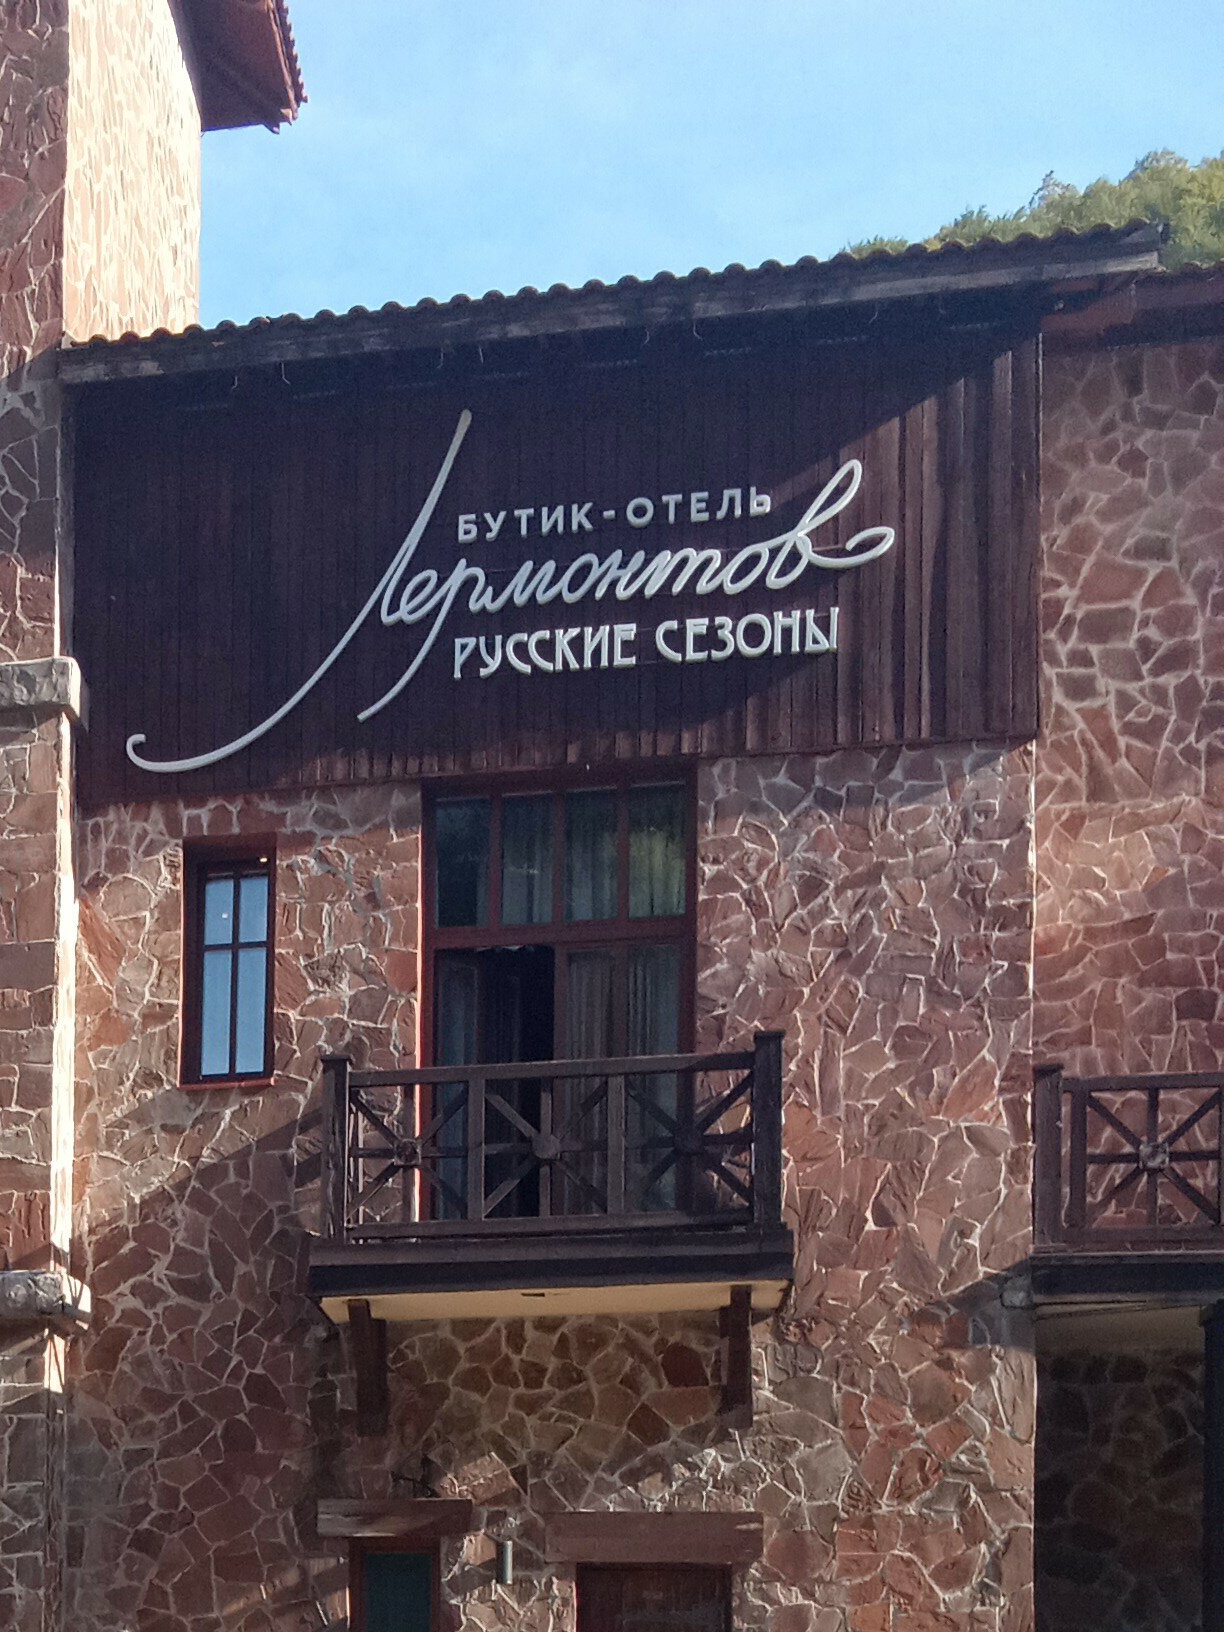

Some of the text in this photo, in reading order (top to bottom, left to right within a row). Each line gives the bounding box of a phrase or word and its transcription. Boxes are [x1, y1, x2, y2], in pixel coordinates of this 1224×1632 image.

[457, 486, 773, 543] БУТИК-ОТЕЛЬ
[126, 408, 896, 772] Лермонтов
[453, 606, 841, 680] РУССКИЕ СЕЗОНЫ
